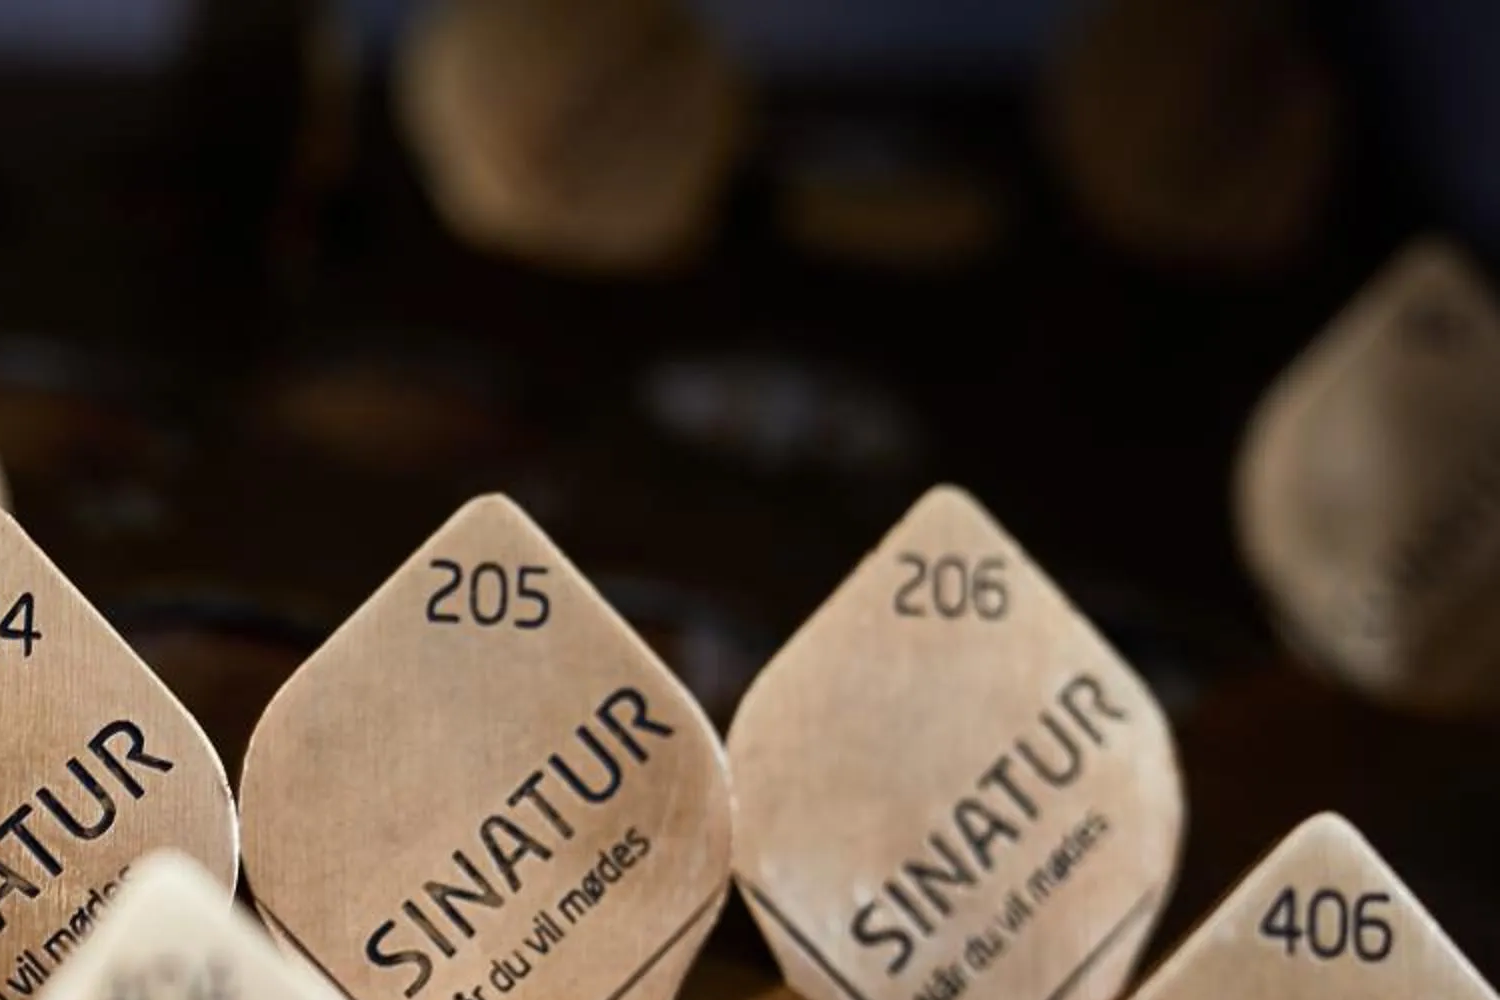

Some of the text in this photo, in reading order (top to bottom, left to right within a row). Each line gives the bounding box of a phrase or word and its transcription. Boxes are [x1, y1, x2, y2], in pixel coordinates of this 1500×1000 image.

[425, 559, 551, 629] 205
[893, 552, 1010, 621] 206
[364, 686, 674, 998] SINATUR
[850, 671, 1129, 976] SINATUR
[489, 950, 533, 994] du
[522, 909, 566, 956] vil
[556, 825, 651, 925] mødes
[1259, 886, 1394, 963] 406
[6, 949, 50, 997] vil
